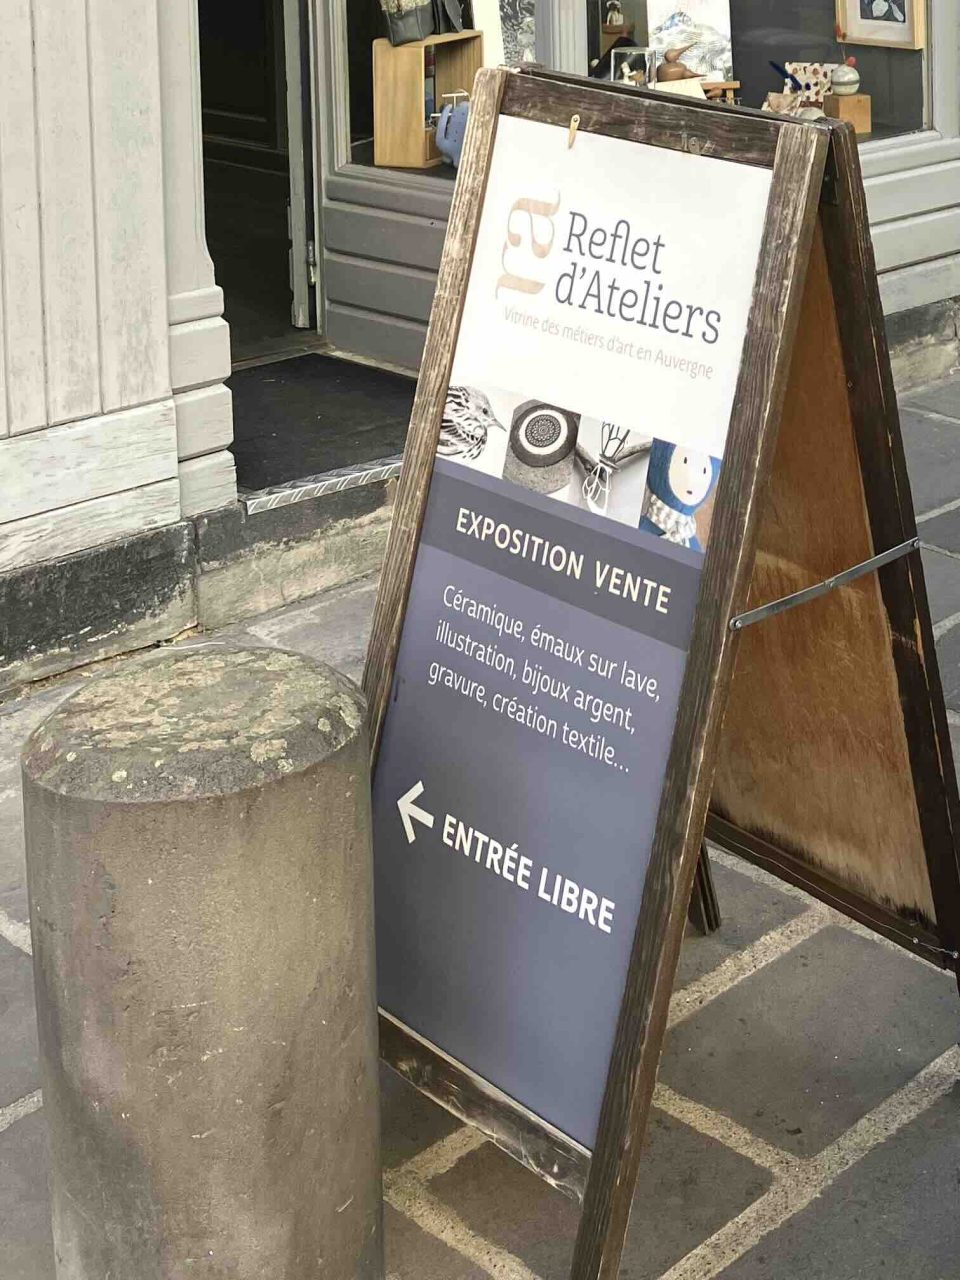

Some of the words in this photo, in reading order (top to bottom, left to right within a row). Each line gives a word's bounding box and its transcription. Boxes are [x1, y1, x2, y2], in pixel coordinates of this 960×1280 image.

[563, 210, 666, 275] Reflet
[504, 305, 540, 330] Vitrine
[541, 318, 560, 336] des
[562, 323, 605, 349] métiers
[606, 333, 635, 358] d'art
[636, 344, 652, 361] en
[654, 348, 714, 380] Auvergne
[555, 261, 722, 345] d'Ateliers
[455, 507, 584, 580] EXPOSITION
[593, 560, 672, 614] VENTE
[435, 619, 517, 678] illustration,
[522, 663, 570, 701] bijoux
[573, 693, 636, 735] argent,
[443, 584, 526, 642] Céramique,
[530, 624, 584, 666] émaux
[589, 652, 618, 678] sur
[622, 660, 661, 703] lave,
[428, 660, 488, 707] gravure,
[492, 692, 557, 739] création
[442, 814, 531, 890] ENTRÉE
[538, 866, 616, 934] LIBRE
